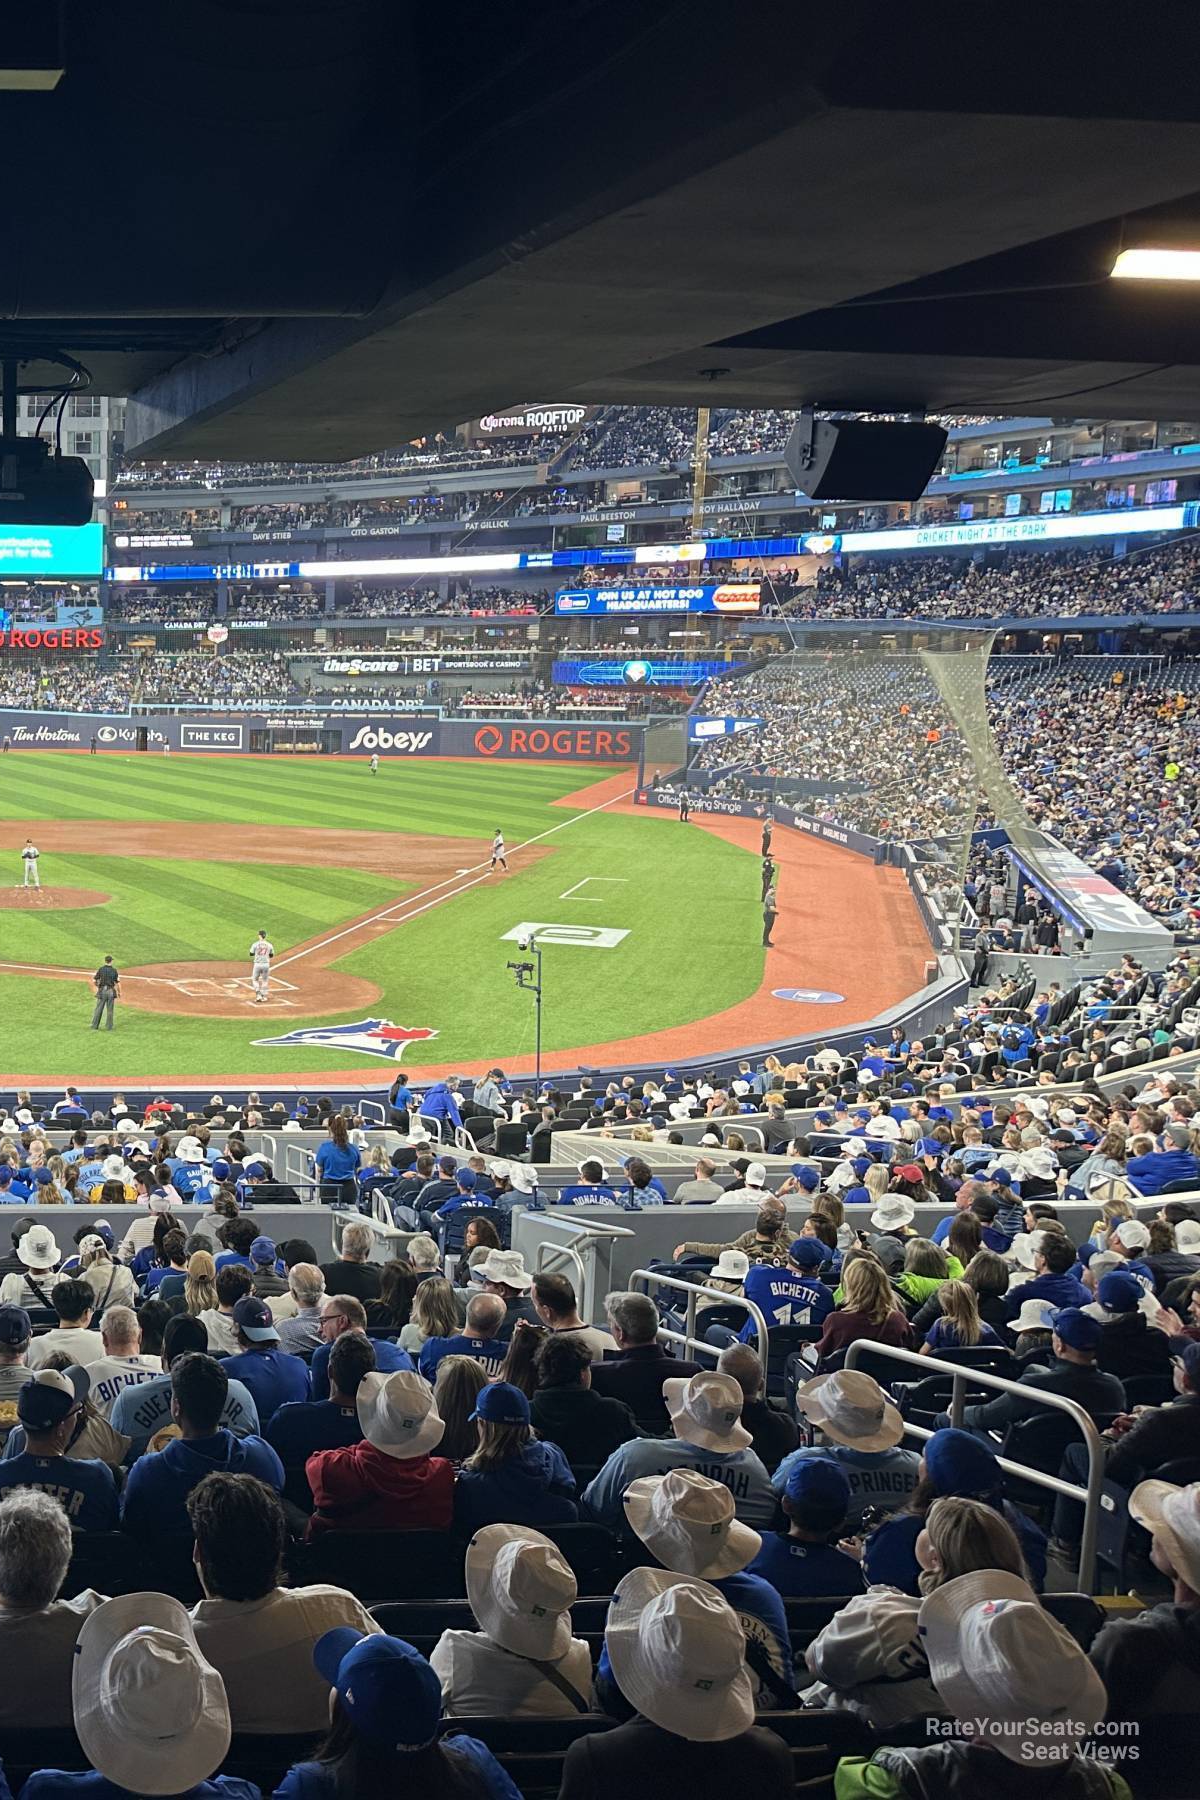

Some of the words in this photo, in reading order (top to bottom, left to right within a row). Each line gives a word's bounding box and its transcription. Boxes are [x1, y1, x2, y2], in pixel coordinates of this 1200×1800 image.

[480, 415, 524, 432] Corona
[526, 409, 585, 427] ROOFTOP
[700, 504, 716, 514] ROY
[717, 501, 760, 513] HALLADAY
[581, 513, 599, 522] PAUL
[601, 511, 636, 520] BEESTON
[351, 528, 368, 537] CITO
[370, 526, 399, 535] GASTON
[465, 521, 480, 530] PAT
[481, 520, 509, 529] GILLICK
[272, 532, 291, 540] STIEB
[917, 530, 954, 544] CRICKET
[958, 528, 985, 540] NIGHT
[987, 527, 998, 538] AT
[1001, 526, 1018, 537] THE
[1022, 524, 1047, 536] PARK
[596, 592, 618, 601] JOIN
[621, 591, 635, 600] US
[637, 591, 650, 600] AT
[654, 590, 677, 599] HOT
[679, 589, 703, 599] DOG
[606, 600, 689, 610] HEADQUARTERS!
[194, 621, 207, 629] DRY
[9, 629, 101, 649] ROGERS
[323, 659, 399, 672] theScore
[413, 659, 441, 672] BET
[12, 726, 33, 741] Tim
[35, 726, 81, 742] Hortons
[188, 732, 210, 741] THE
[213, 733, 235, 741] KEG
[350, 725, 432, 752] Sobeys
[511, 729, 630, 755] ROGERS
[687, 797, 712, 811] oofing
[714, 799, 742, 814] Shingle
[770, 1281, 820, 1305] BICHETTE
[849, 1470, 920, 1495] PRINGE
[741, 1614, 770, 1641] DIN
